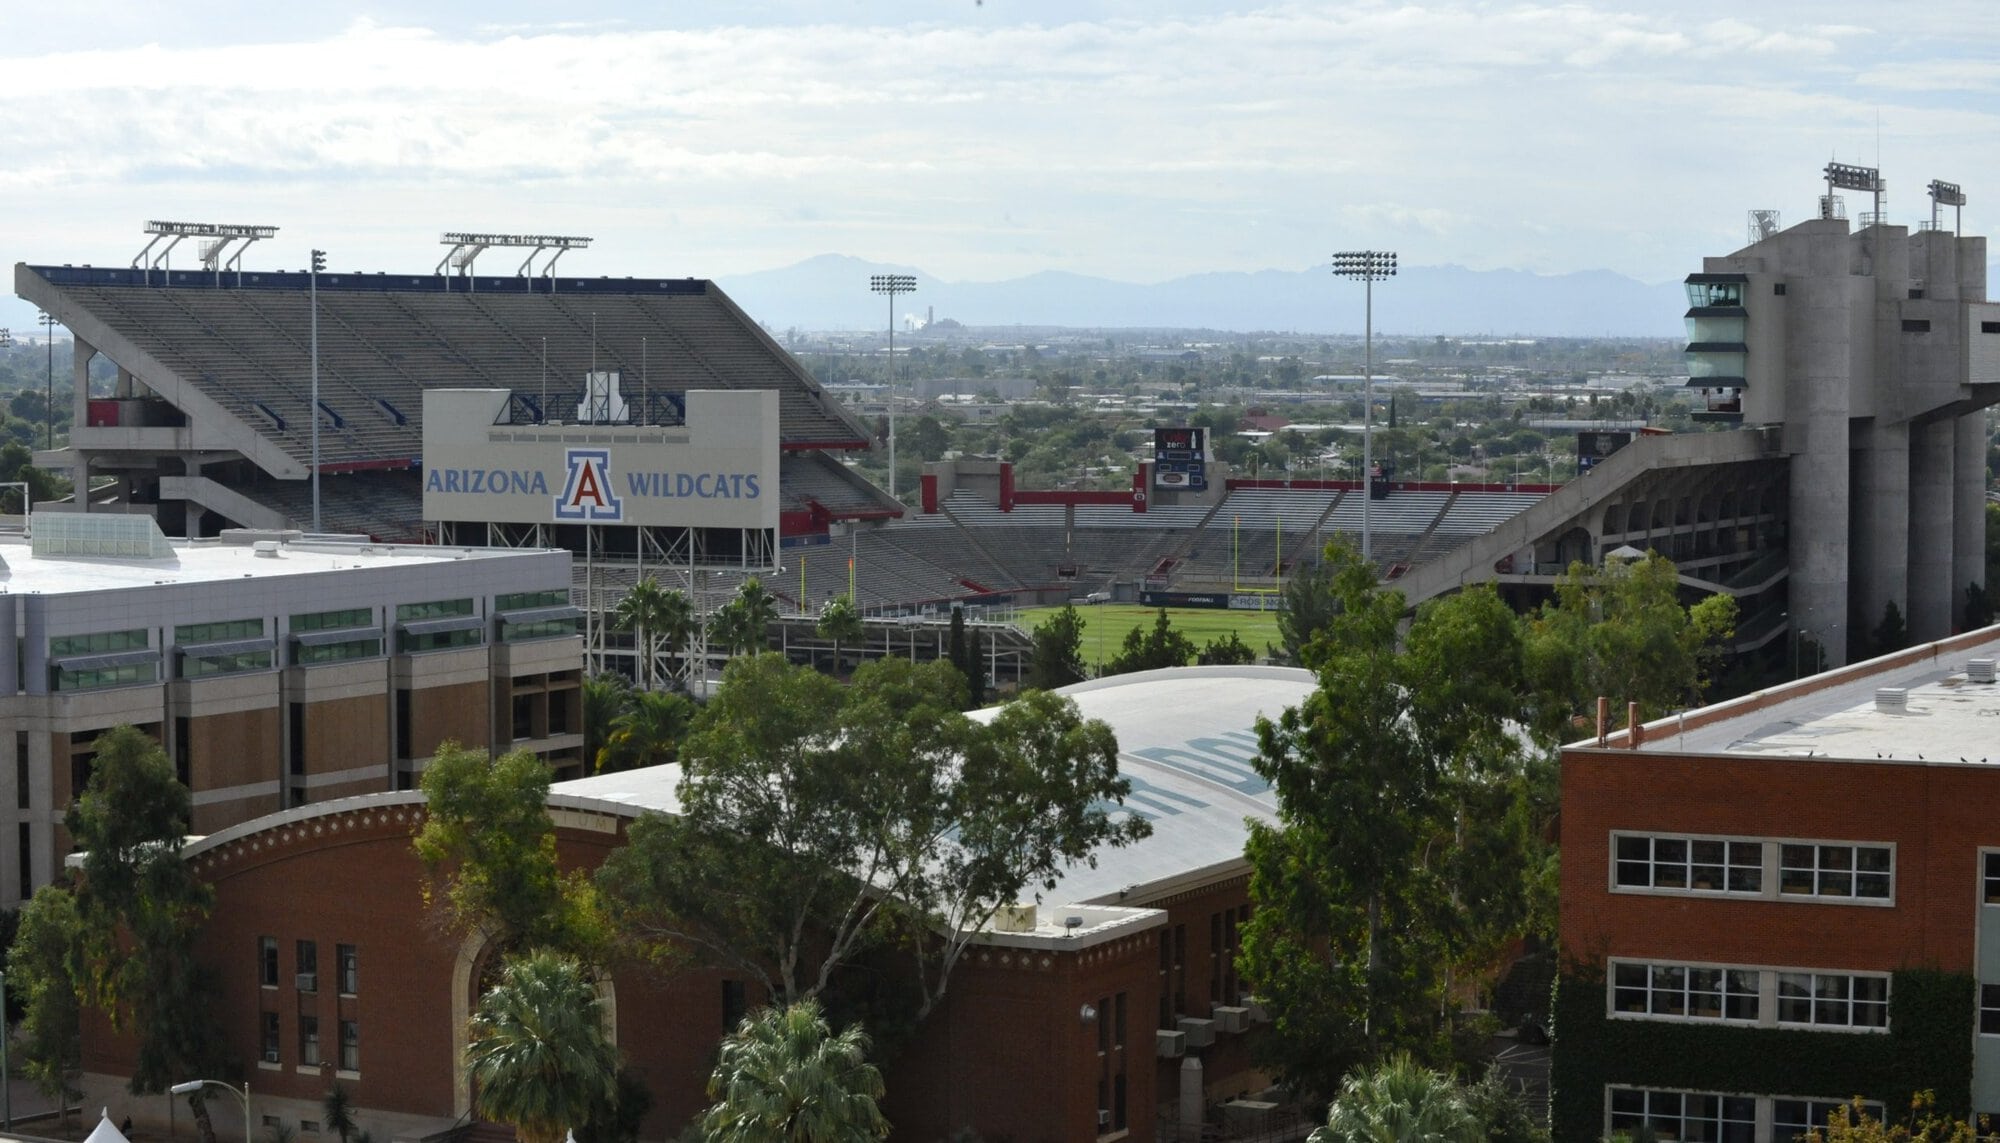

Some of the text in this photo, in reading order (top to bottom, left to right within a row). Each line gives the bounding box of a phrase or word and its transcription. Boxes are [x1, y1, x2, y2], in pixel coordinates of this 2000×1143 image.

[425, 447, 760, 522] ARIZONA A WILDCATS
